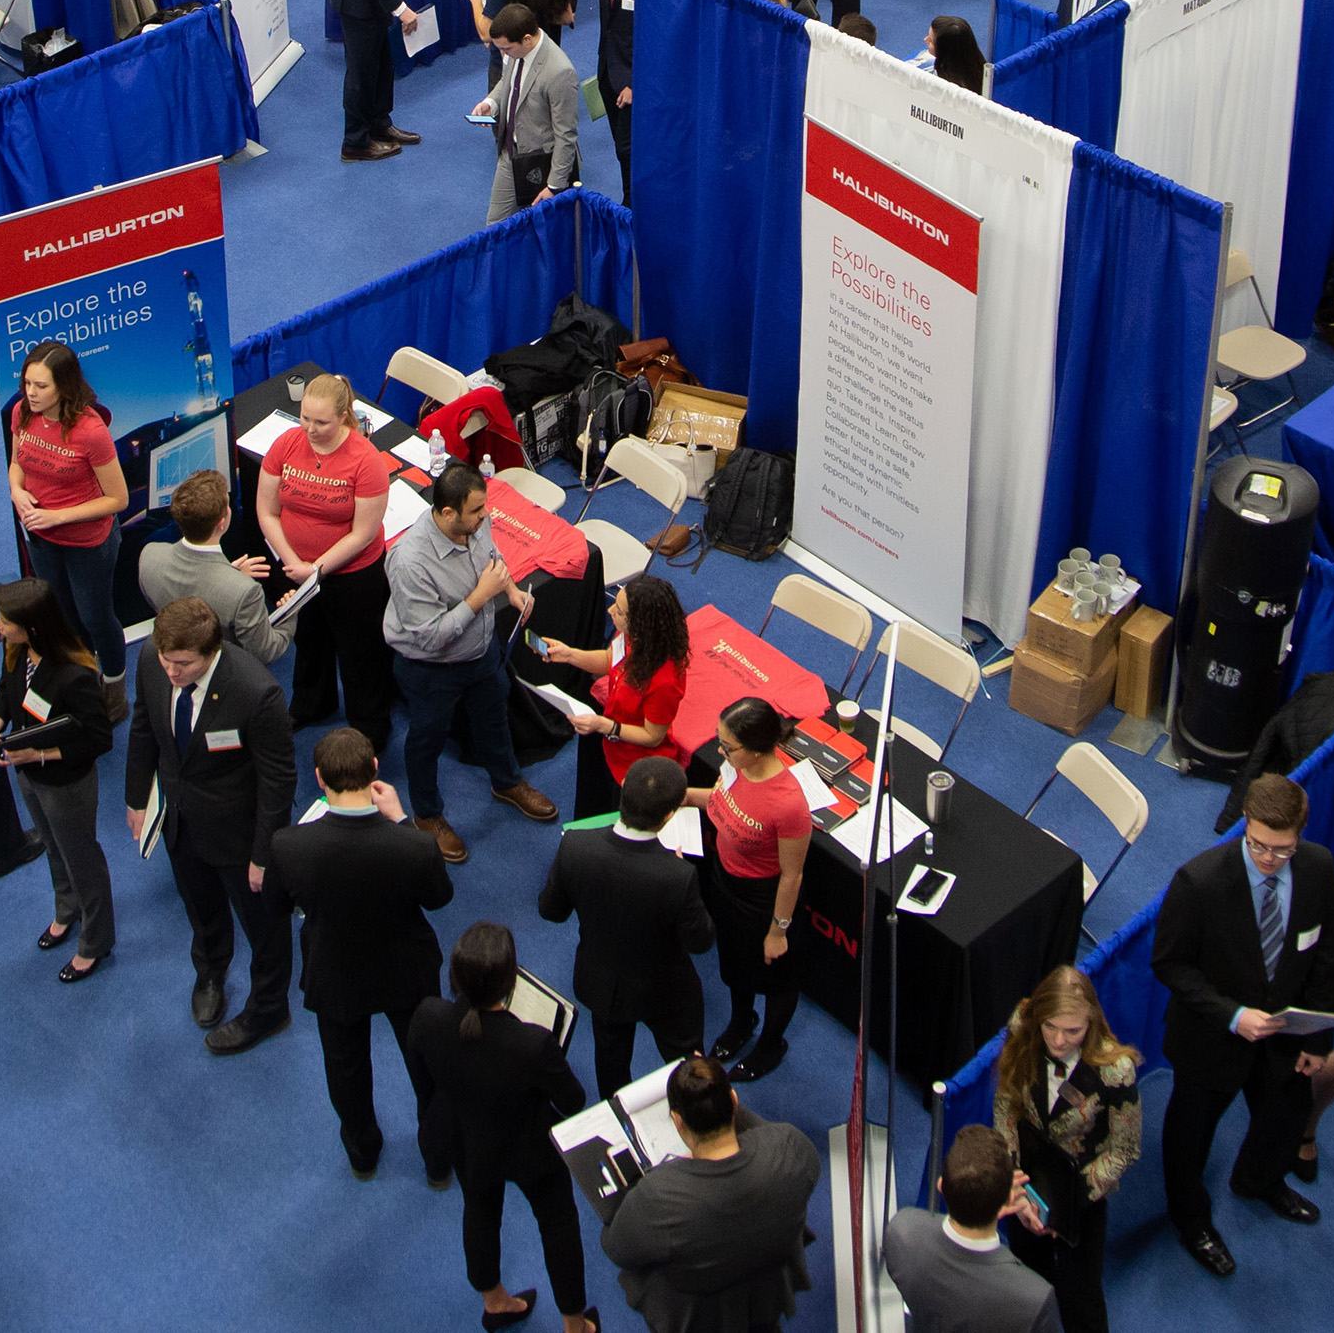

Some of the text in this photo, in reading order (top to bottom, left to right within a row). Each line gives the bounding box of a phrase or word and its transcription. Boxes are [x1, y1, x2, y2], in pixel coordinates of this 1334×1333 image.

[911, 104, 964, 140] HALLIBURTON
[24, 205, 184, 261] HALLIBURTON
[832, 167, 949, 246] HALLIBURTON
[831, 261, 932, 337] Possibilities
[833, 236, 931, 311] Explore the
[6, 280, 147, 335] Explore the
[829, 306, 879, 343] bring energy
[846, 301, 914, 347] career that helps
[828, 336, 933, 405] people who want make
[840, 325, 924, 385] Halliburton, want
[827, 365, 924, 429] and challenge status
[846, 388, 863, 407] Take
[17, 430, 76, 458] Halliburton
[825, 420, 874, 457] better future
[826, 405, 908, 463] Collaborate create
[281, 463, 348, 487] Halliburton
[823, 463, 869, 497] opportunity.
[824, 435, 903, 489] ethical and dynamic
[824, 450, 920, 514] workplace with limitless
[490, 505, 542, 542] Halliburton
[821, 505, 900, 560] halliburton.com/careers
[822, 483, 905, 540] Are person?
[714, 638, 770, 683] Halliburton
